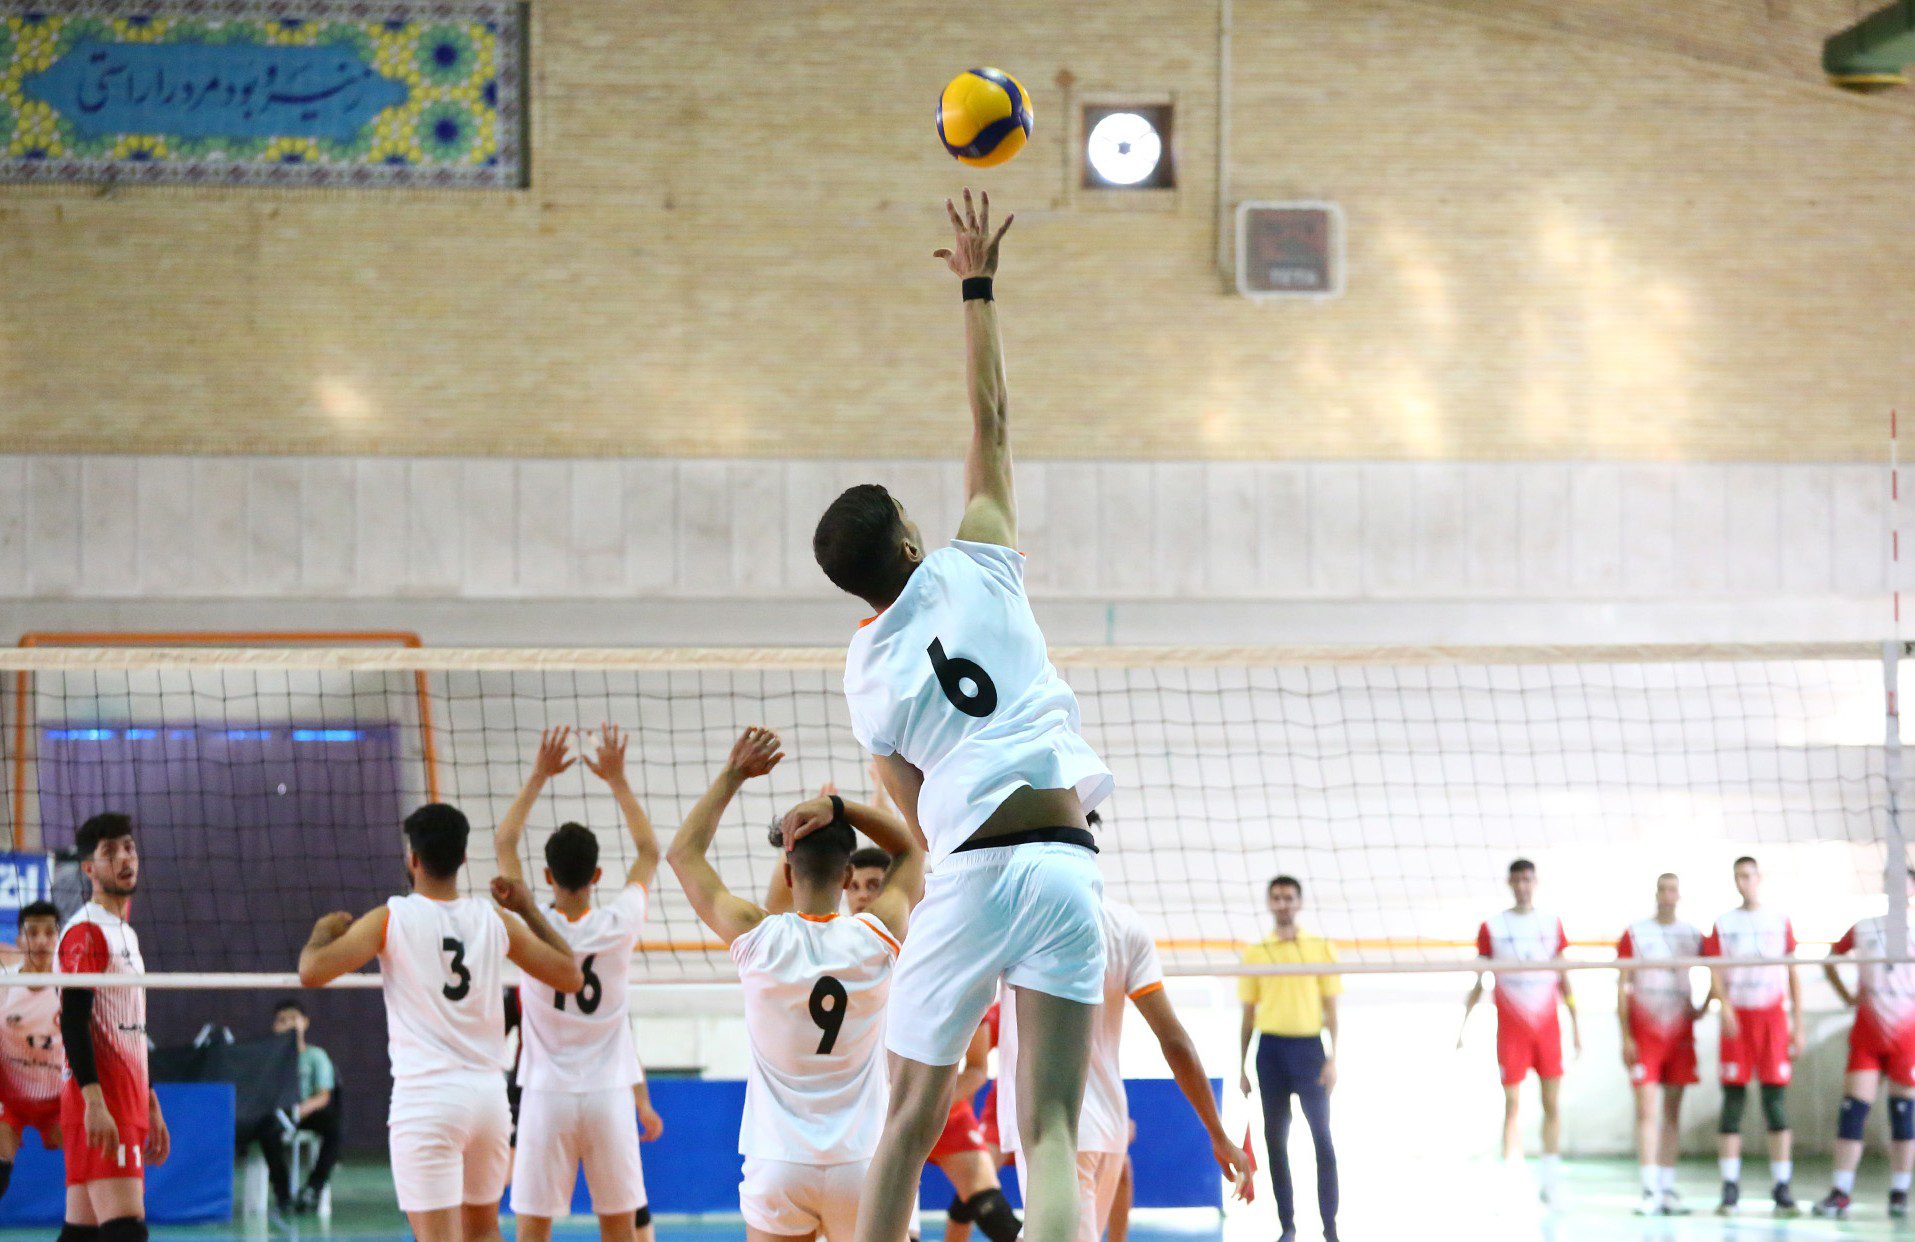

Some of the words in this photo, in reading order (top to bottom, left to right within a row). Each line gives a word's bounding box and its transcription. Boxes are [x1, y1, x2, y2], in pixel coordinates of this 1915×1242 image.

[926, 636, 998, 718] 6
[442, 937, 471, 1001] 3
[808, 975, 848, 1054] 9
